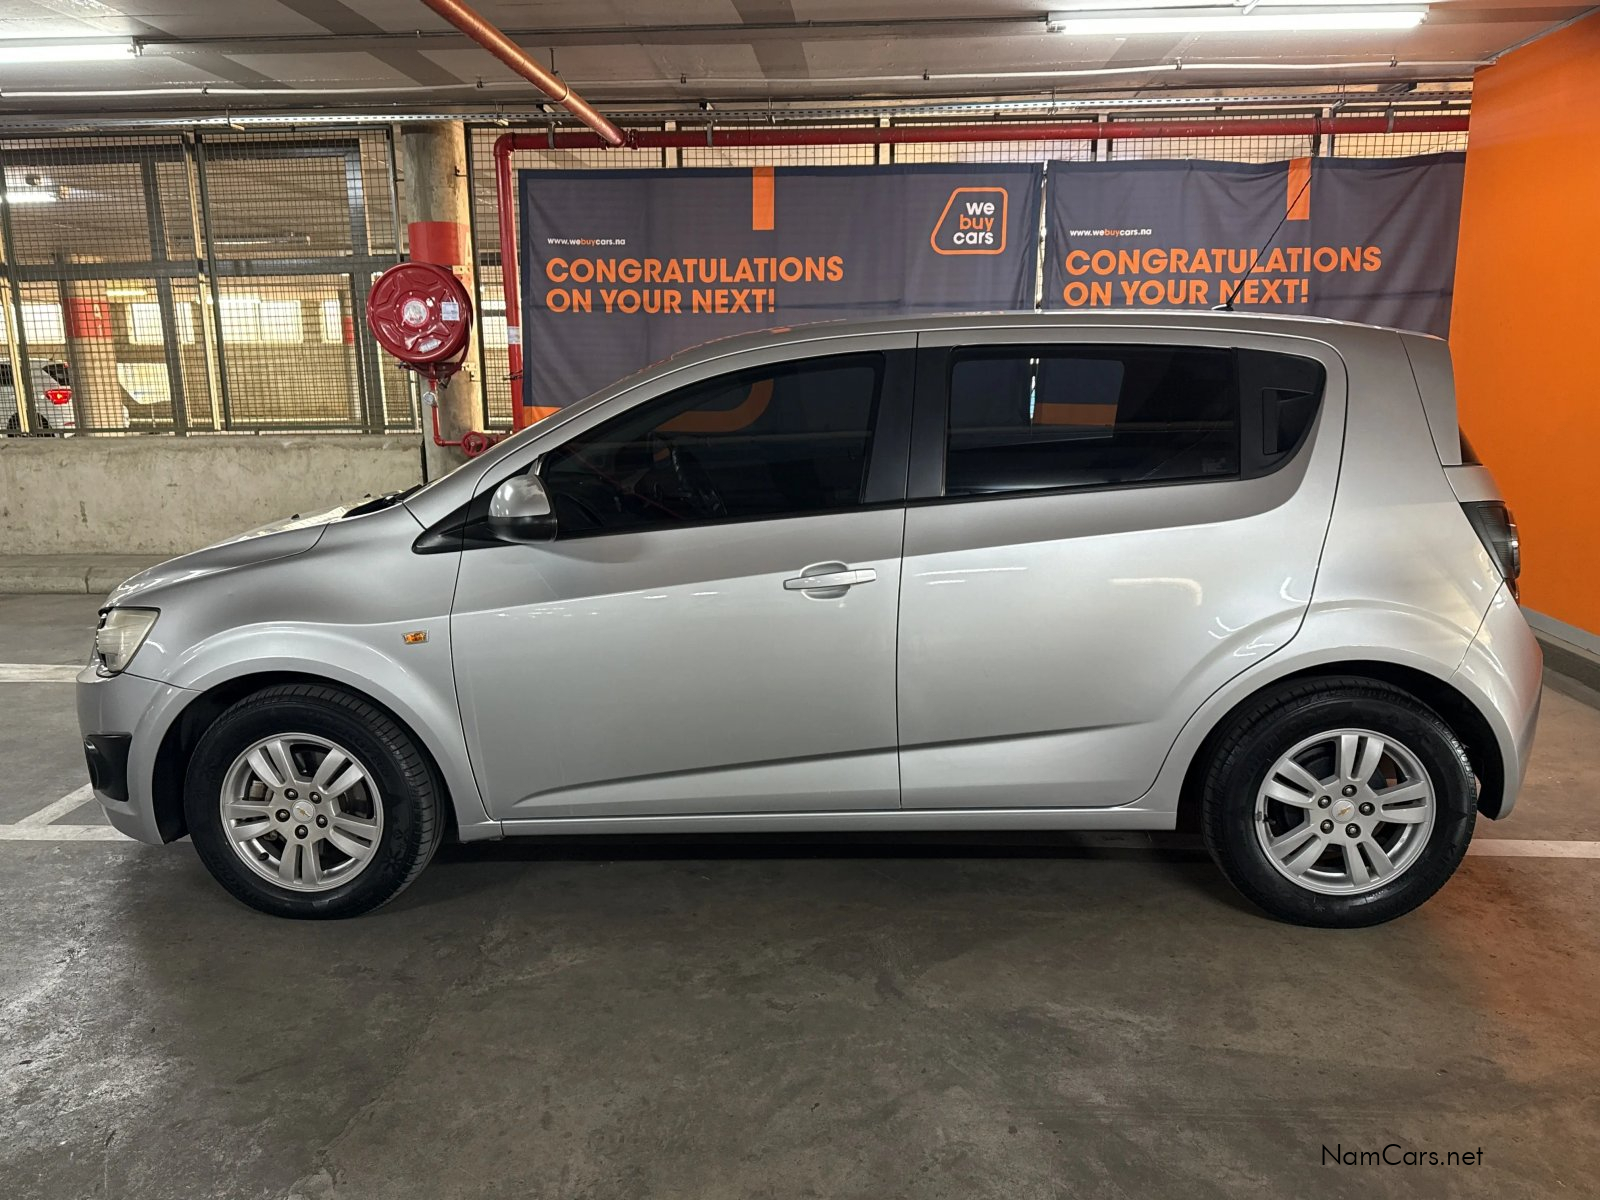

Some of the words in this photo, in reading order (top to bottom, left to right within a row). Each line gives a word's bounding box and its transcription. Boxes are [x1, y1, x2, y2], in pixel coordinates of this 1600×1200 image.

[965, 202, 995, 215] we
[959, 214, 994, 232] buy
[547, 237, 626, 247] www.webuycars.na
[953, 231, 994, 244] cars
[1069, 228, 1153, 238] www.webuycars.na
[545, 255, 844, 283] CONGRATULATIONS
[1065, 246, 1382, 275] CONGRATULATIONS
[545, 288, 592, 313] ON
[600, 288, 682, 314] YOUR
[692, 288, 775, 314] NEXT!
[1063, 281, 1112, 307] ON
[1121, 279, 1208, 306] YOUR
[1219, 278, 1309, 305] NEXT!
